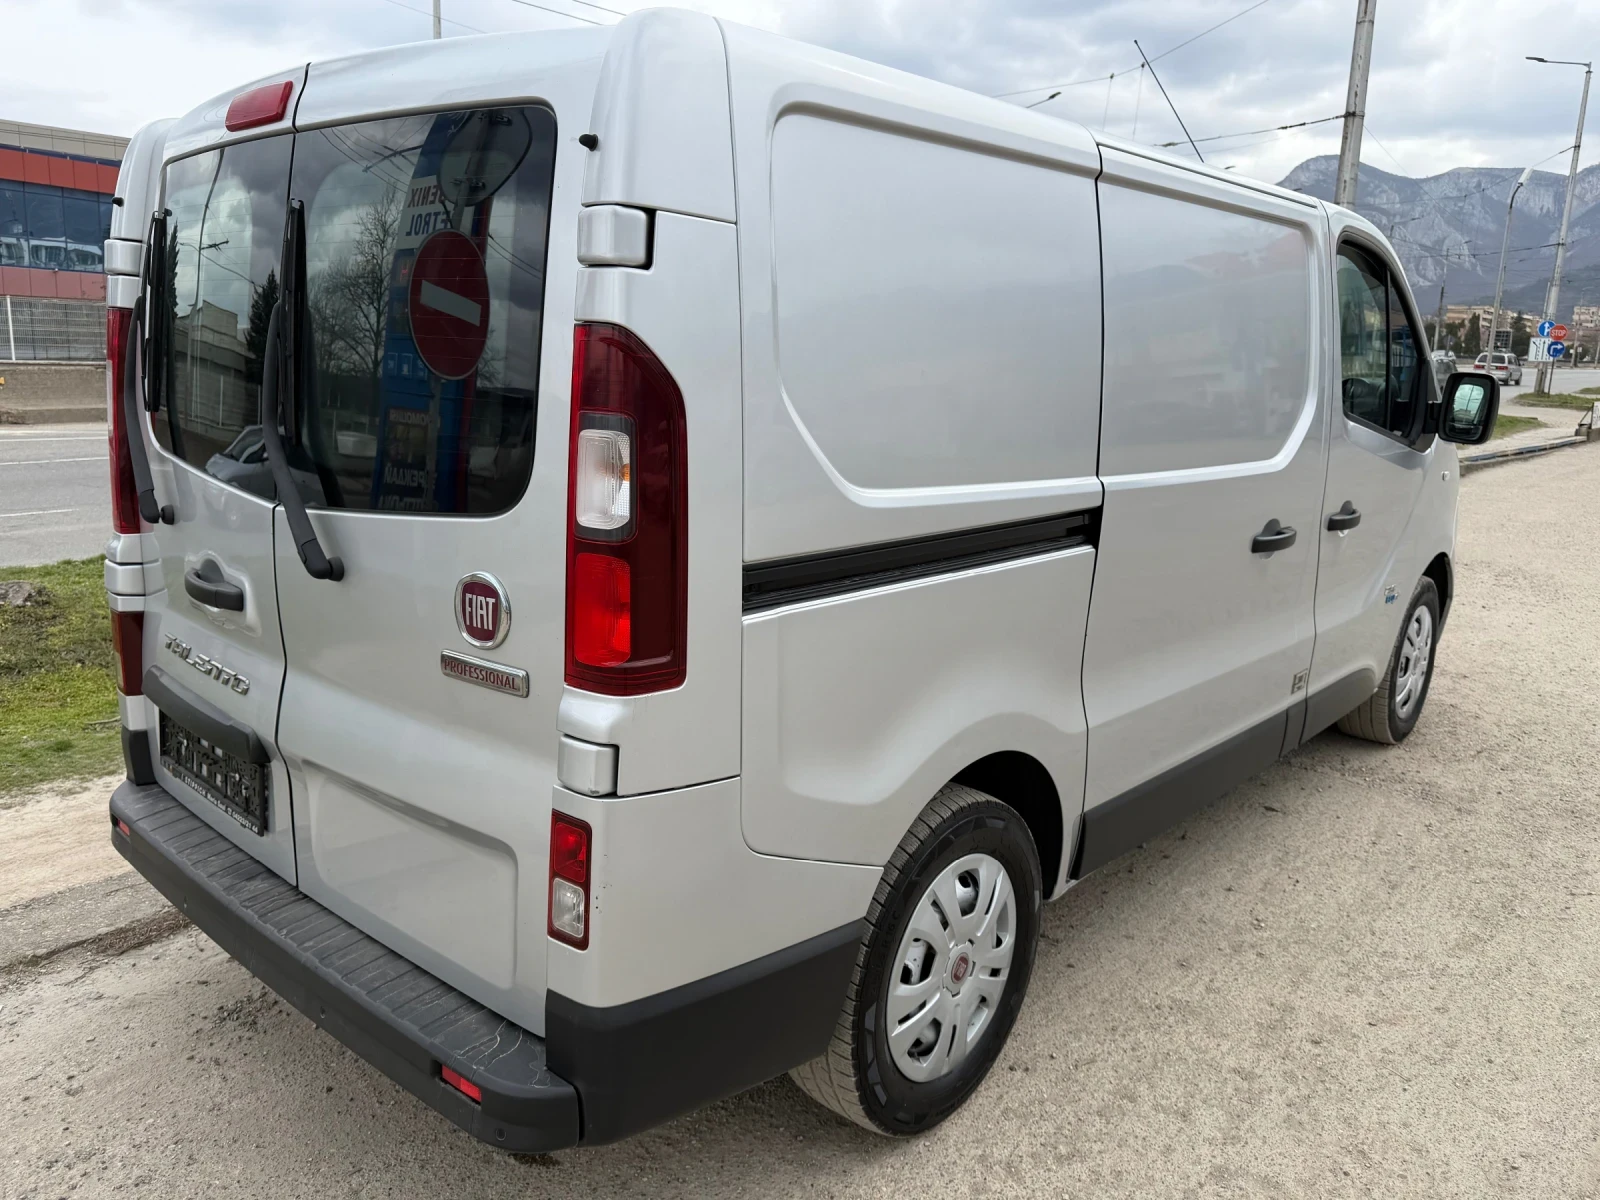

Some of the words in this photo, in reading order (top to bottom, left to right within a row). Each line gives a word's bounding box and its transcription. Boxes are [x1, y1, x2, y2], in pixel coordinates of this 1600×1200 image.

[1551, 329, 1567, 337] STOP
[465, 592, 496, 631] FIAT
[164, 632, 250, 696] TALENTO
[443, 658, 518, 690] PROFESSIONAL
